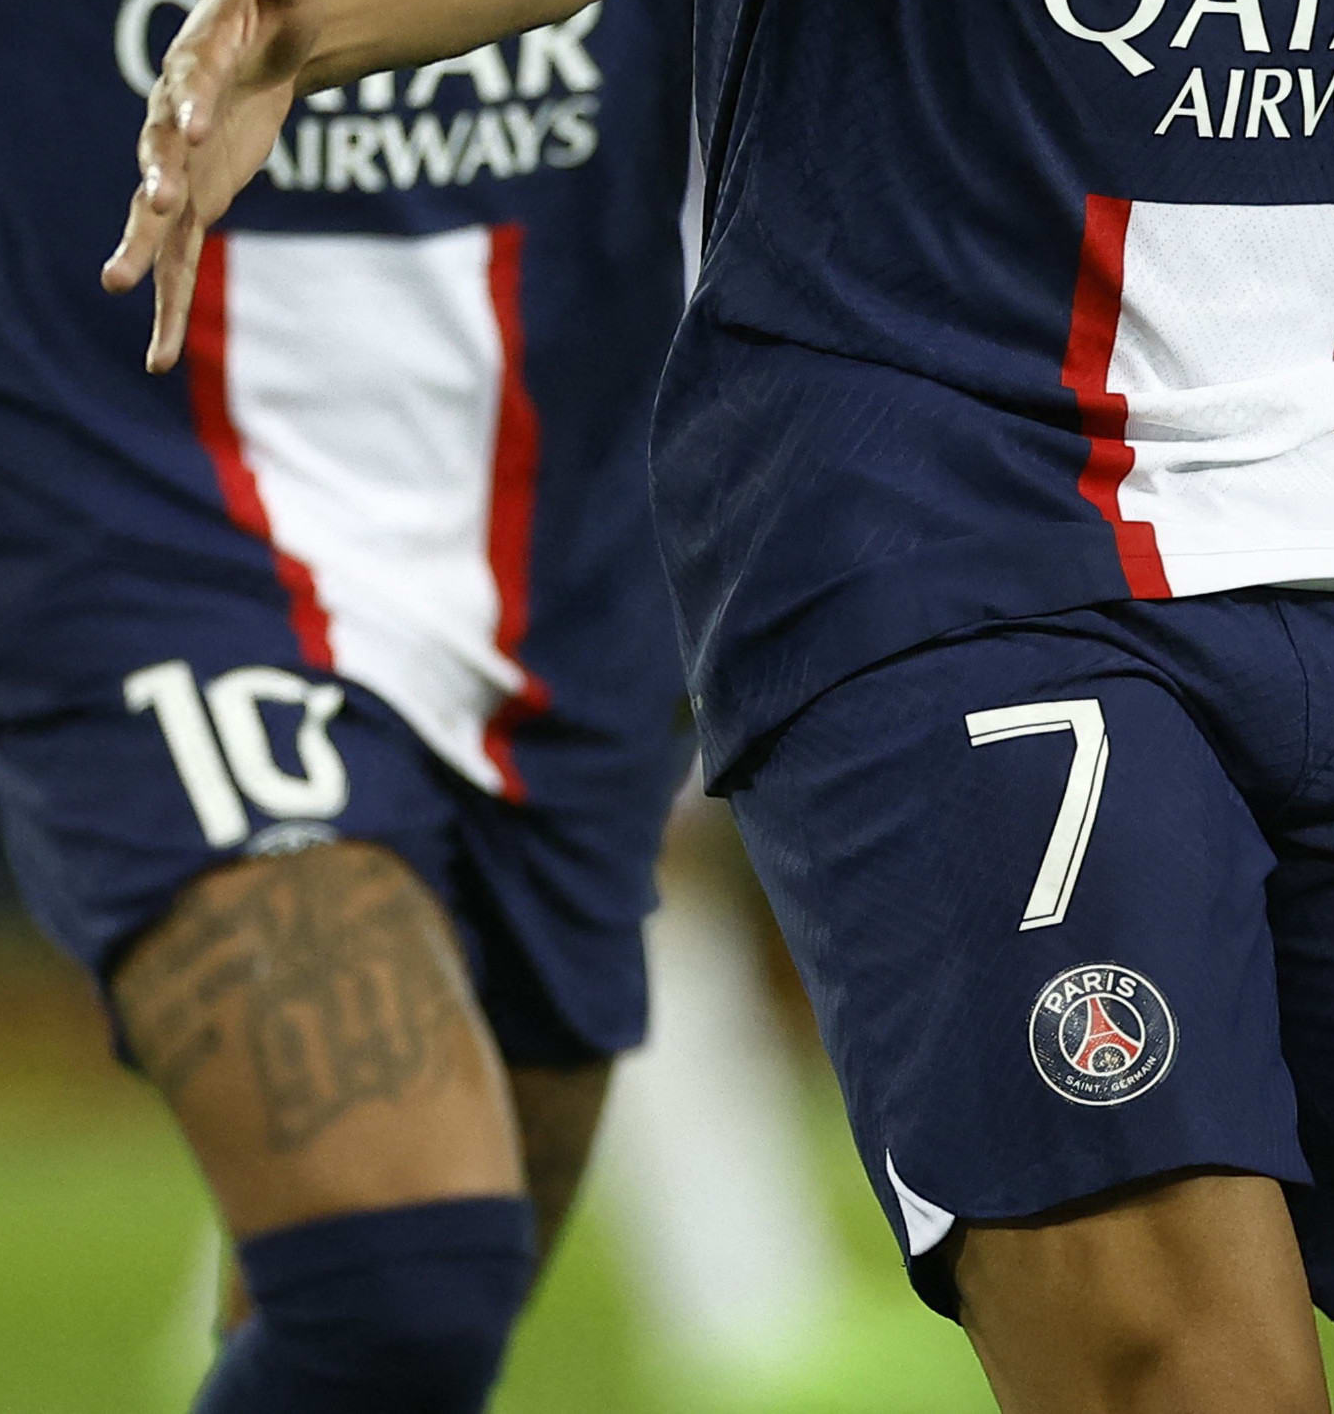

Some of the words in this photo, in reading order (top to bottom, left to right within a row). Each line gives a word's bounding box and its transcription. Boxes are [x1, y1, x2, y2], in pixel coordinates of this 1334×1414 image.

[123, 658, 351, 850] 10
[964, 697, 1110, 932] 7
[1044, 971, 1138, 1014] PARIS
